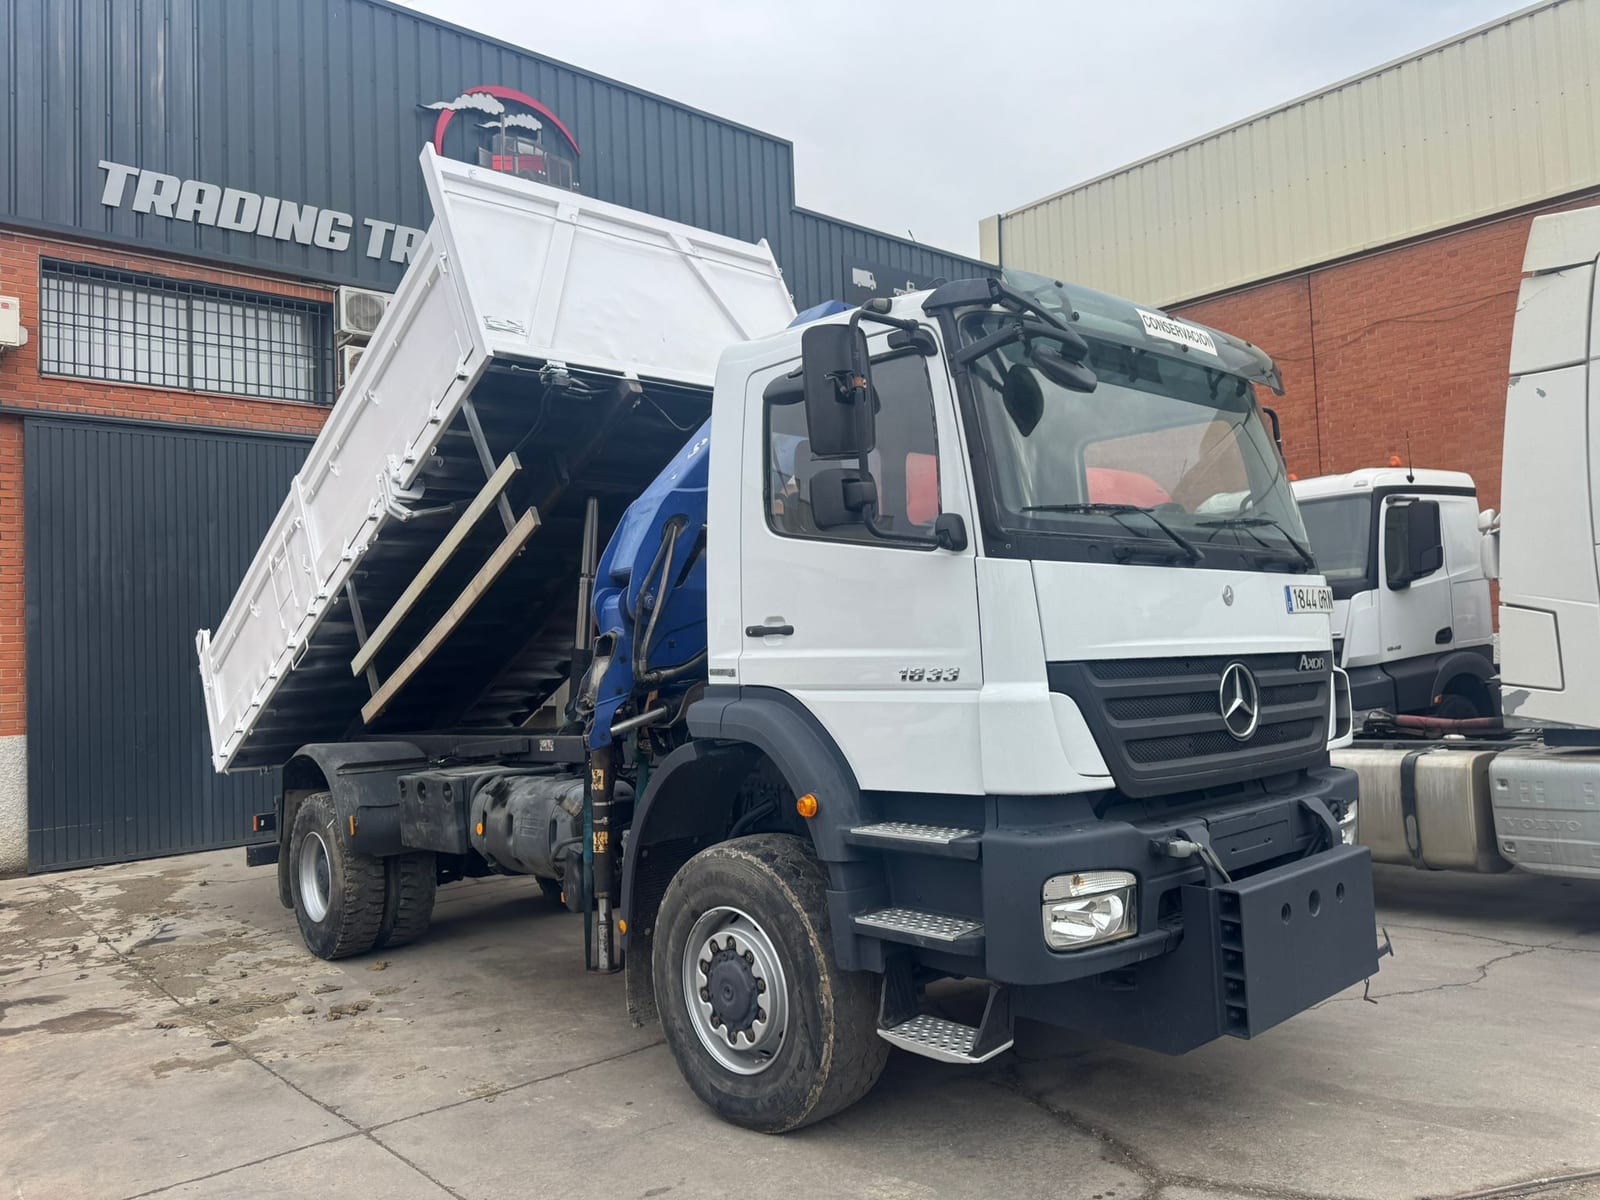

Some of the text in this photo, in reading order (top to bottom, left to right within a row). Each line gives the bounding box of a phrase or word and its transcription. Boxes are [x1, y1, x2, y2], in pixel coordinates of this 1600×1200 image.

[98, 160, 353, 251] TRADING
[1293, 588, 1317, 609] 1844
[898, 667, 960, 682] 1833
[1500, 815, 1582, 833] VOLVO
